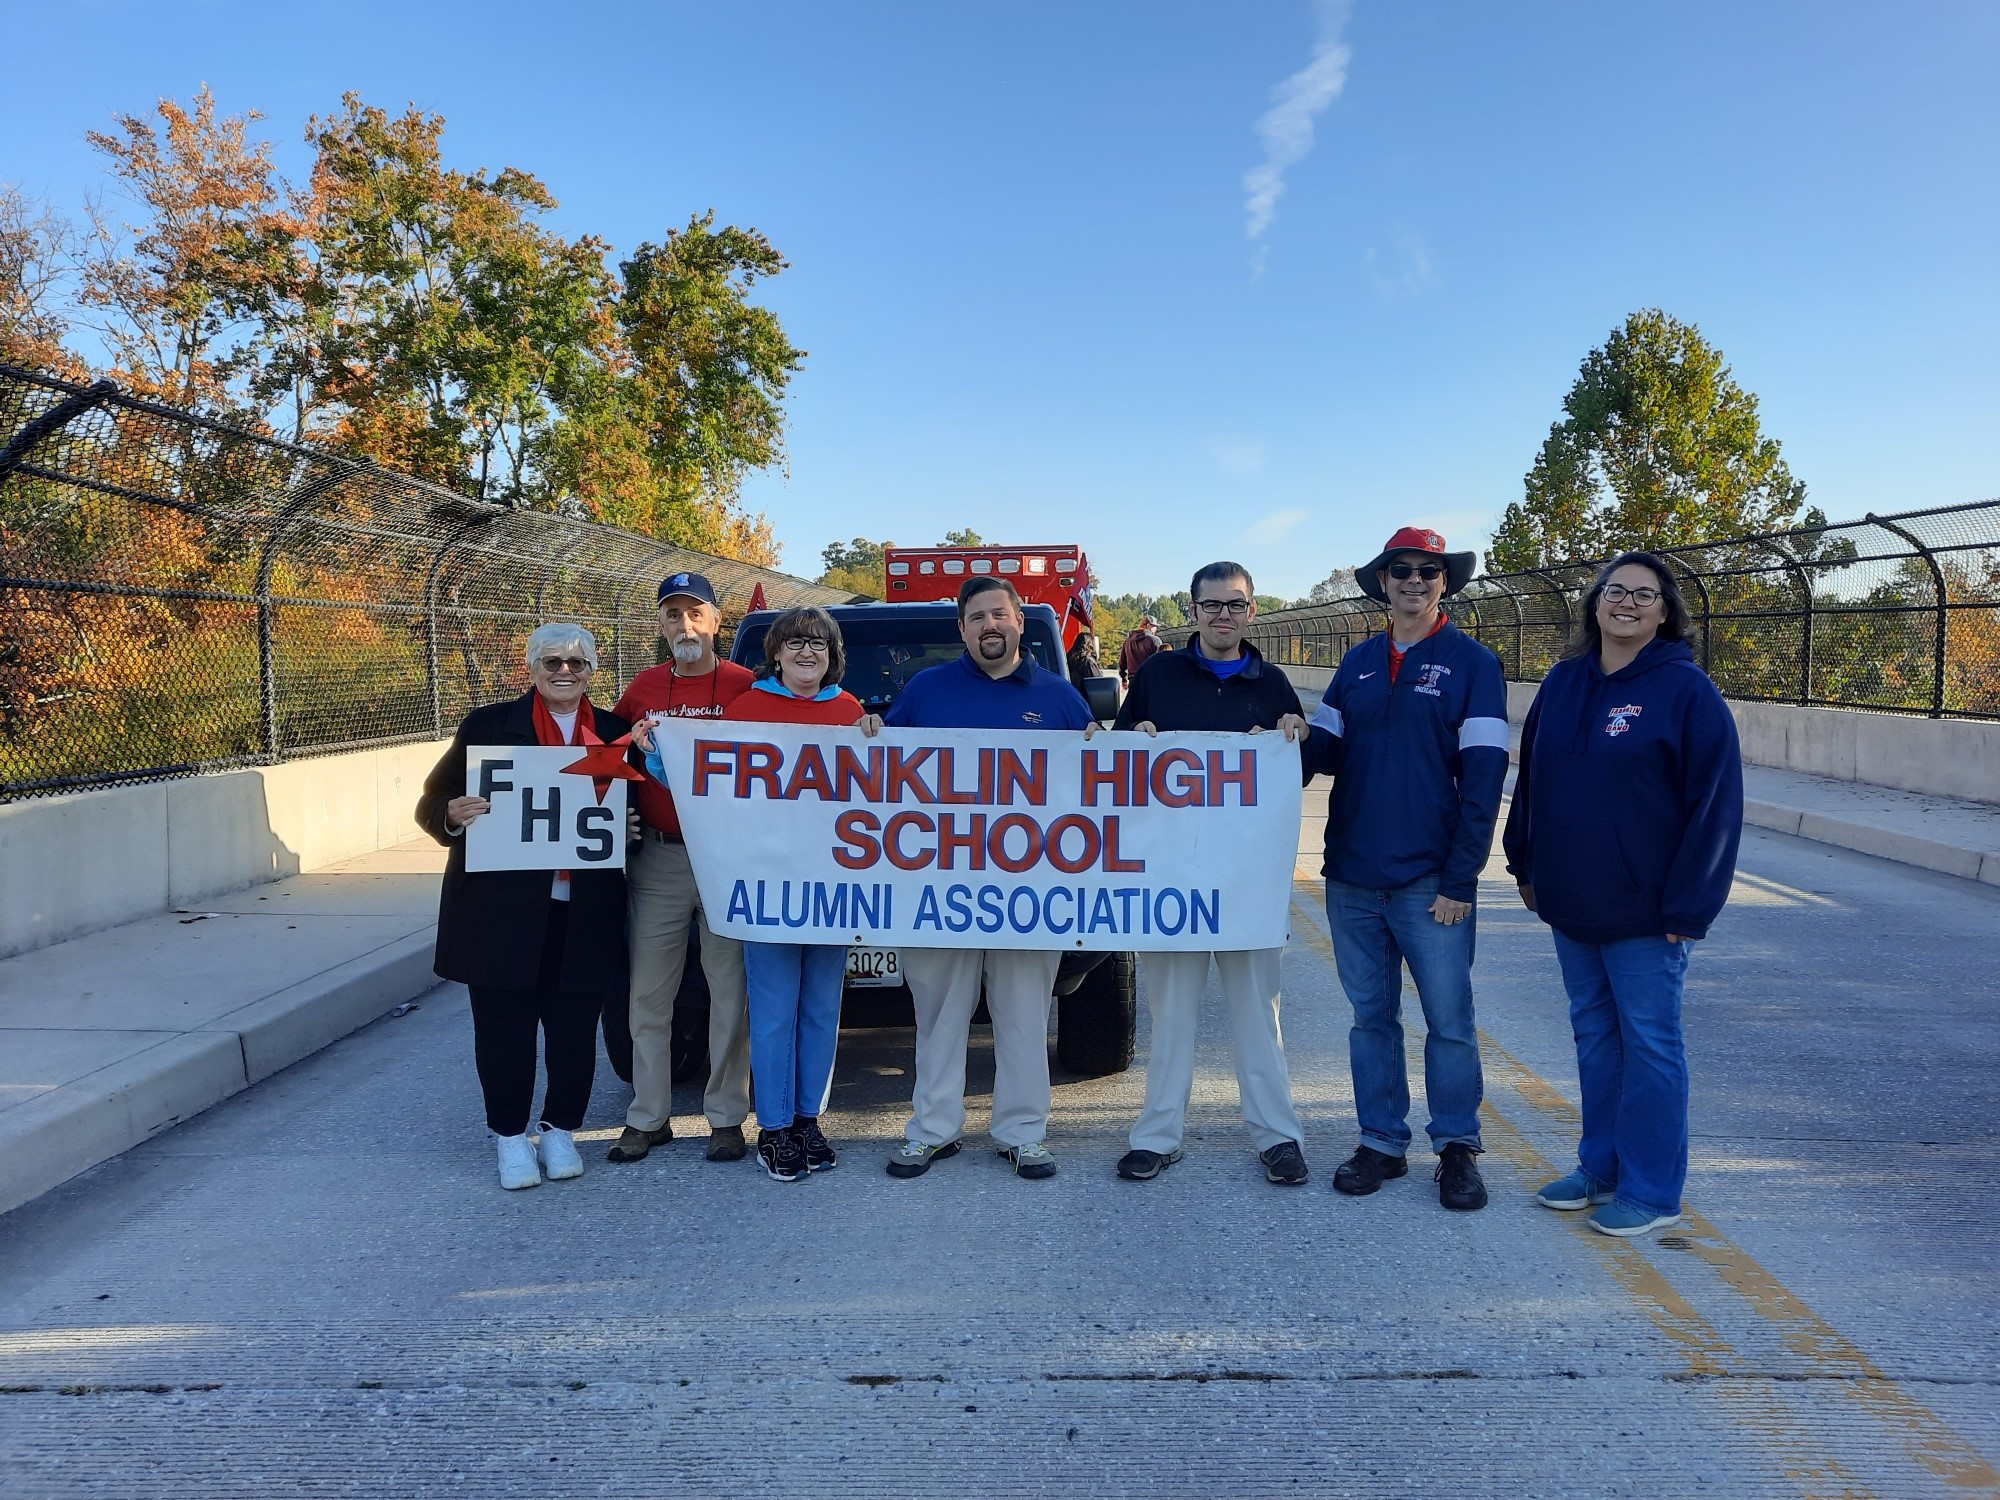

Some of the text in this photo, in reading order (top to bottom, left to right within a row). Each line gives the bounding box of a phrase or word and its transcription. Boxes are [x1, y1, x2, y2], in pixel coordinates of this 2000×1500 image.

[1414, 685, 1441, 697] INDIANS
[692, 738, 1258, 808] FRANKLIN HIGH
[832, 809, 1146, 874] SCHOOL
[726, 879, 1220, 936] ALUMNI ASSOCIATION
[849, 951, 897, 974] 3028
